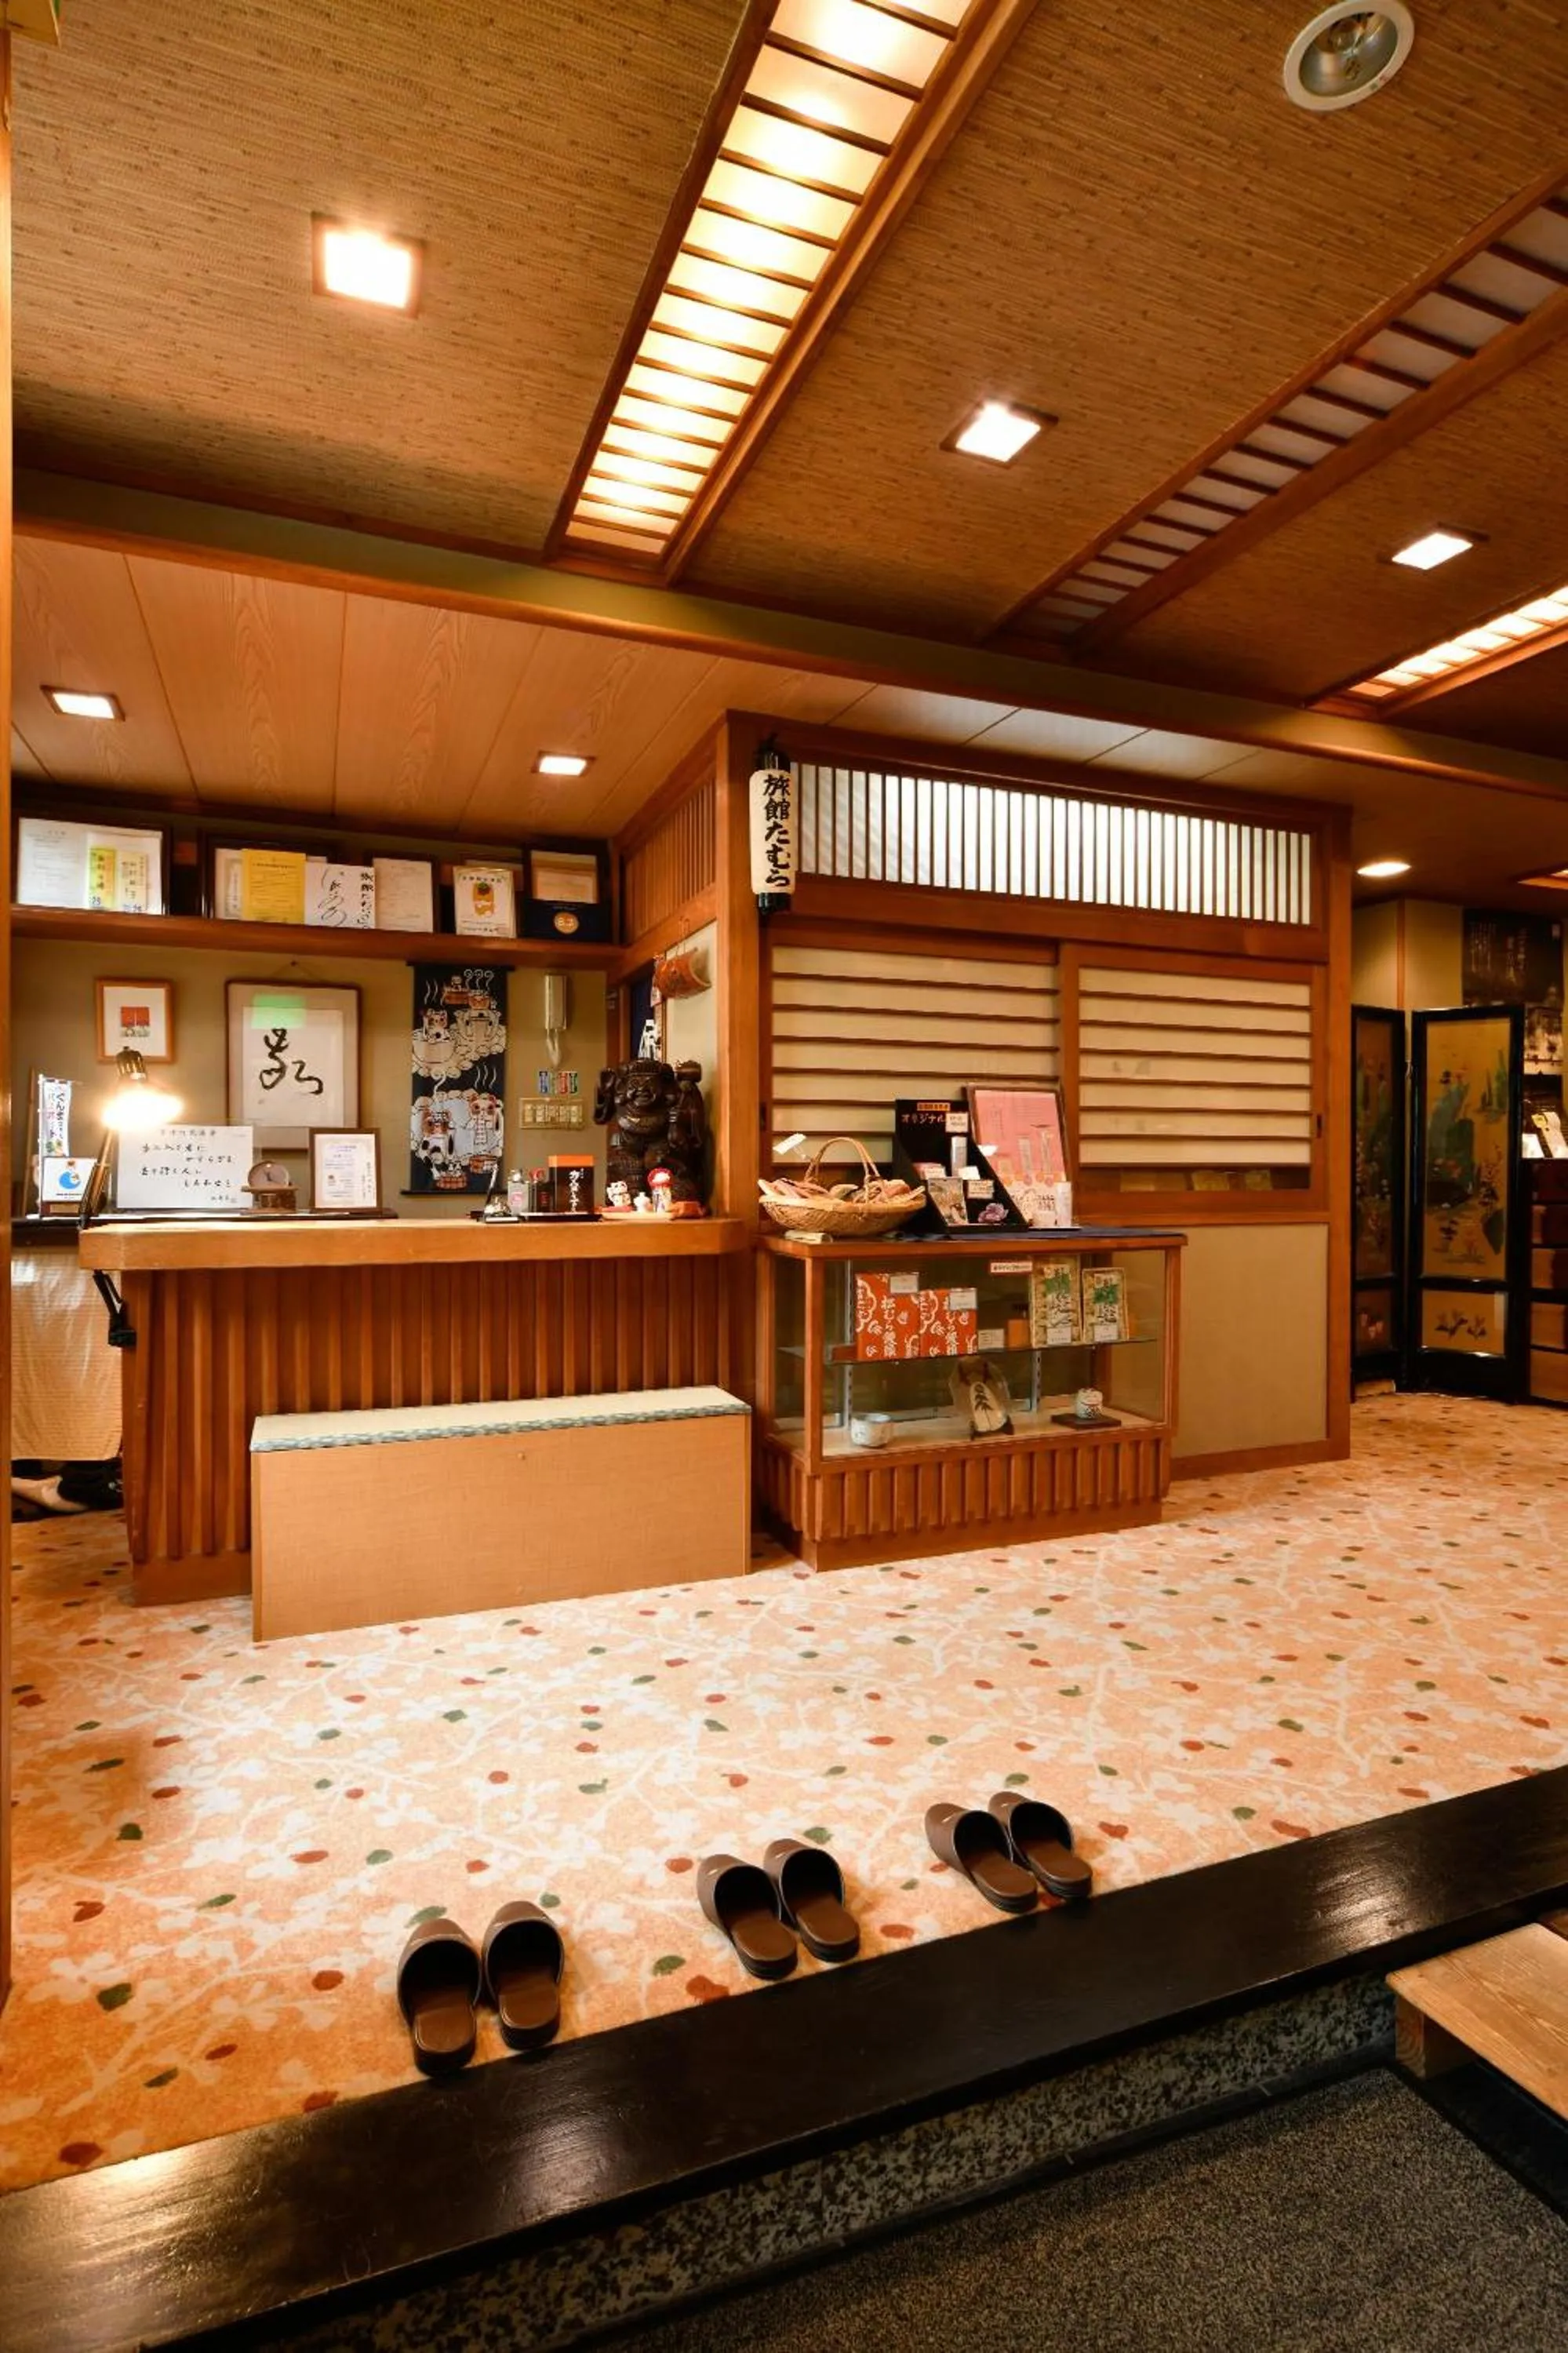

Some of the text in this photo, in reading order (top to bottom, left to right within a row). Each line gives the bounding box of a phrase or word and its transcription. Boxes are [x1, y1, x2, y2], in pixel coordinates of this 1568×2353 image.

[762, 774, 791, 887] 旅館たむら
